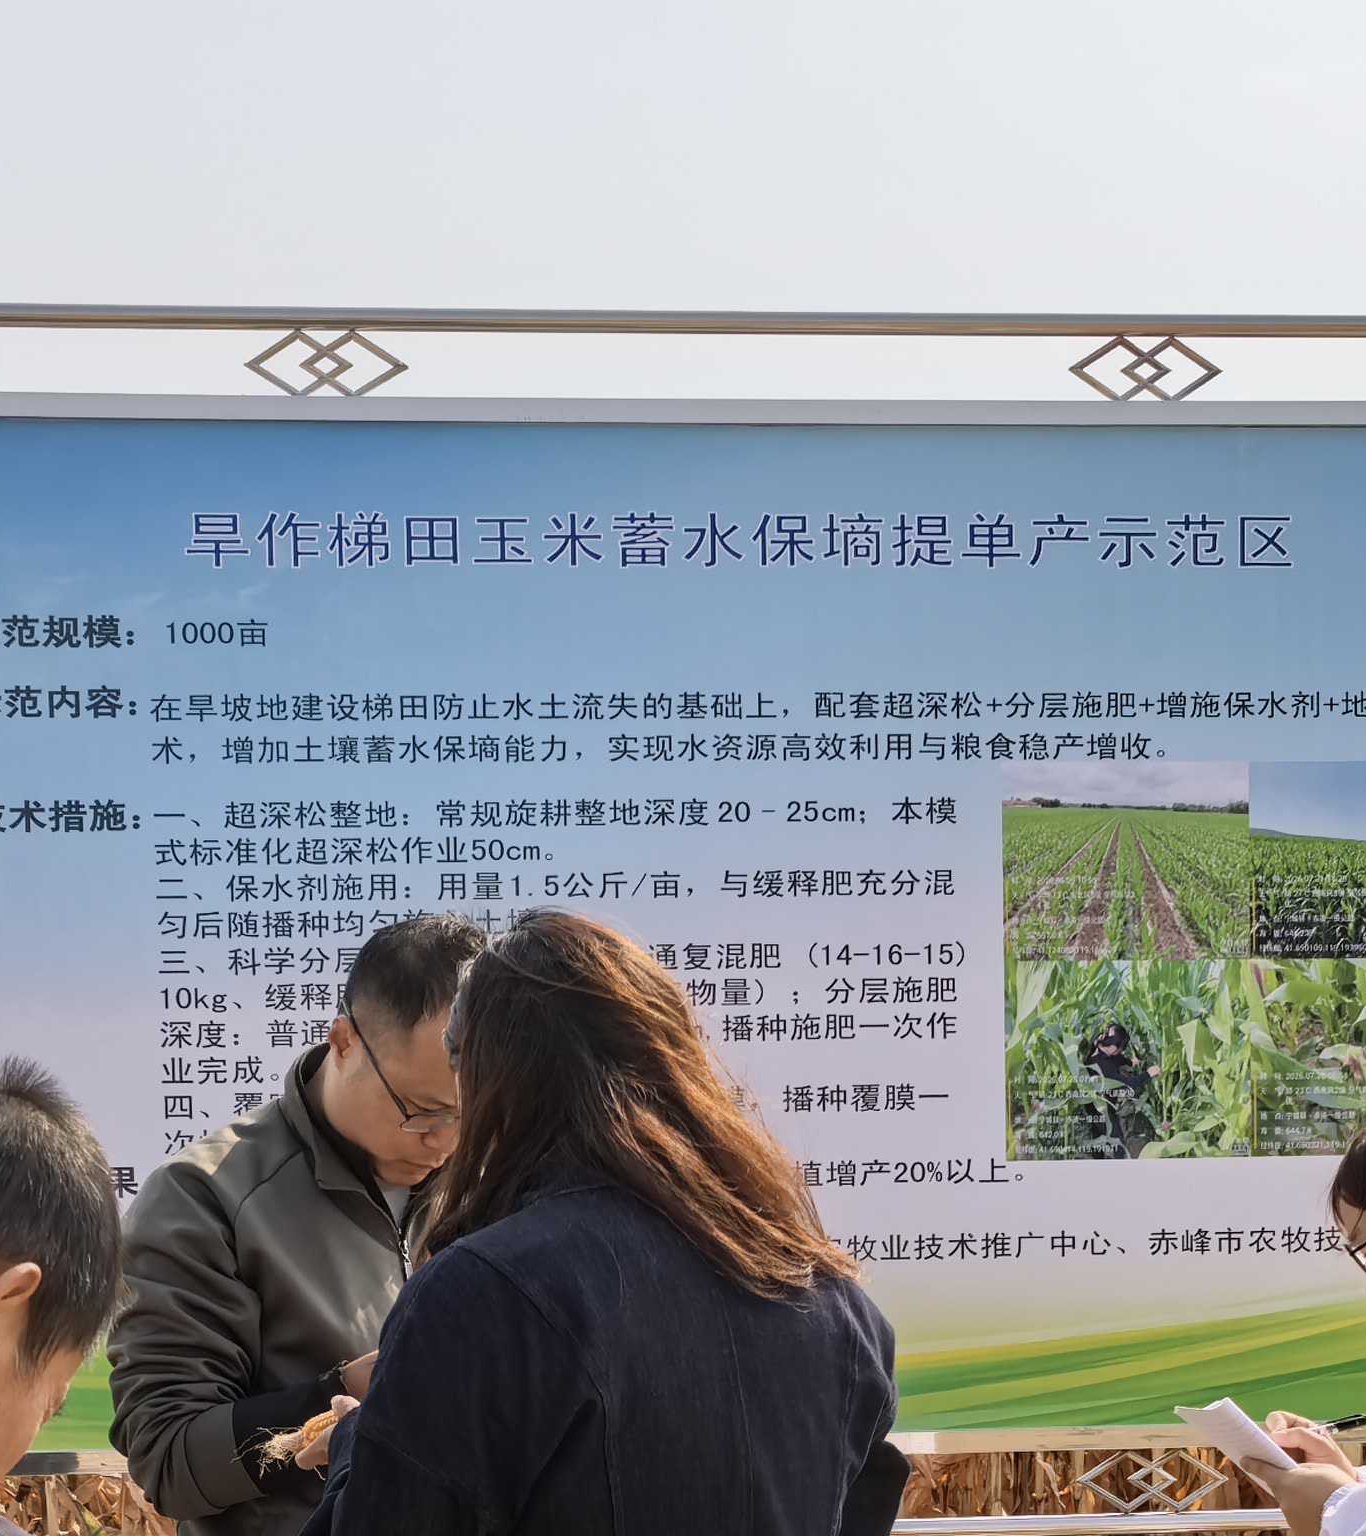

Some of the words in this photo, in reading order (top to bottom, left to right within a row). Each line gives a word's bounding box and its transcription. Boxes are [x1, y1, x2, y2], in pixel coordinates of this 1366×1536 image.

[184, 510, 1293, 569] 旱作梯田玉米蓄水保墒提单产示范区
[166, 618, 269, 648] 1000亩
[151, 731, 1171, 765] 术，增加土壤蓄水保墒能力，实现水资源高效利用与粮食稳产增收。
[155, 837, 555, 867] 式标准化超深松作业50cm。
[161, 1055, 280, 1086] 业完成。
[164, 1093, 284, 1121] 四、覆
